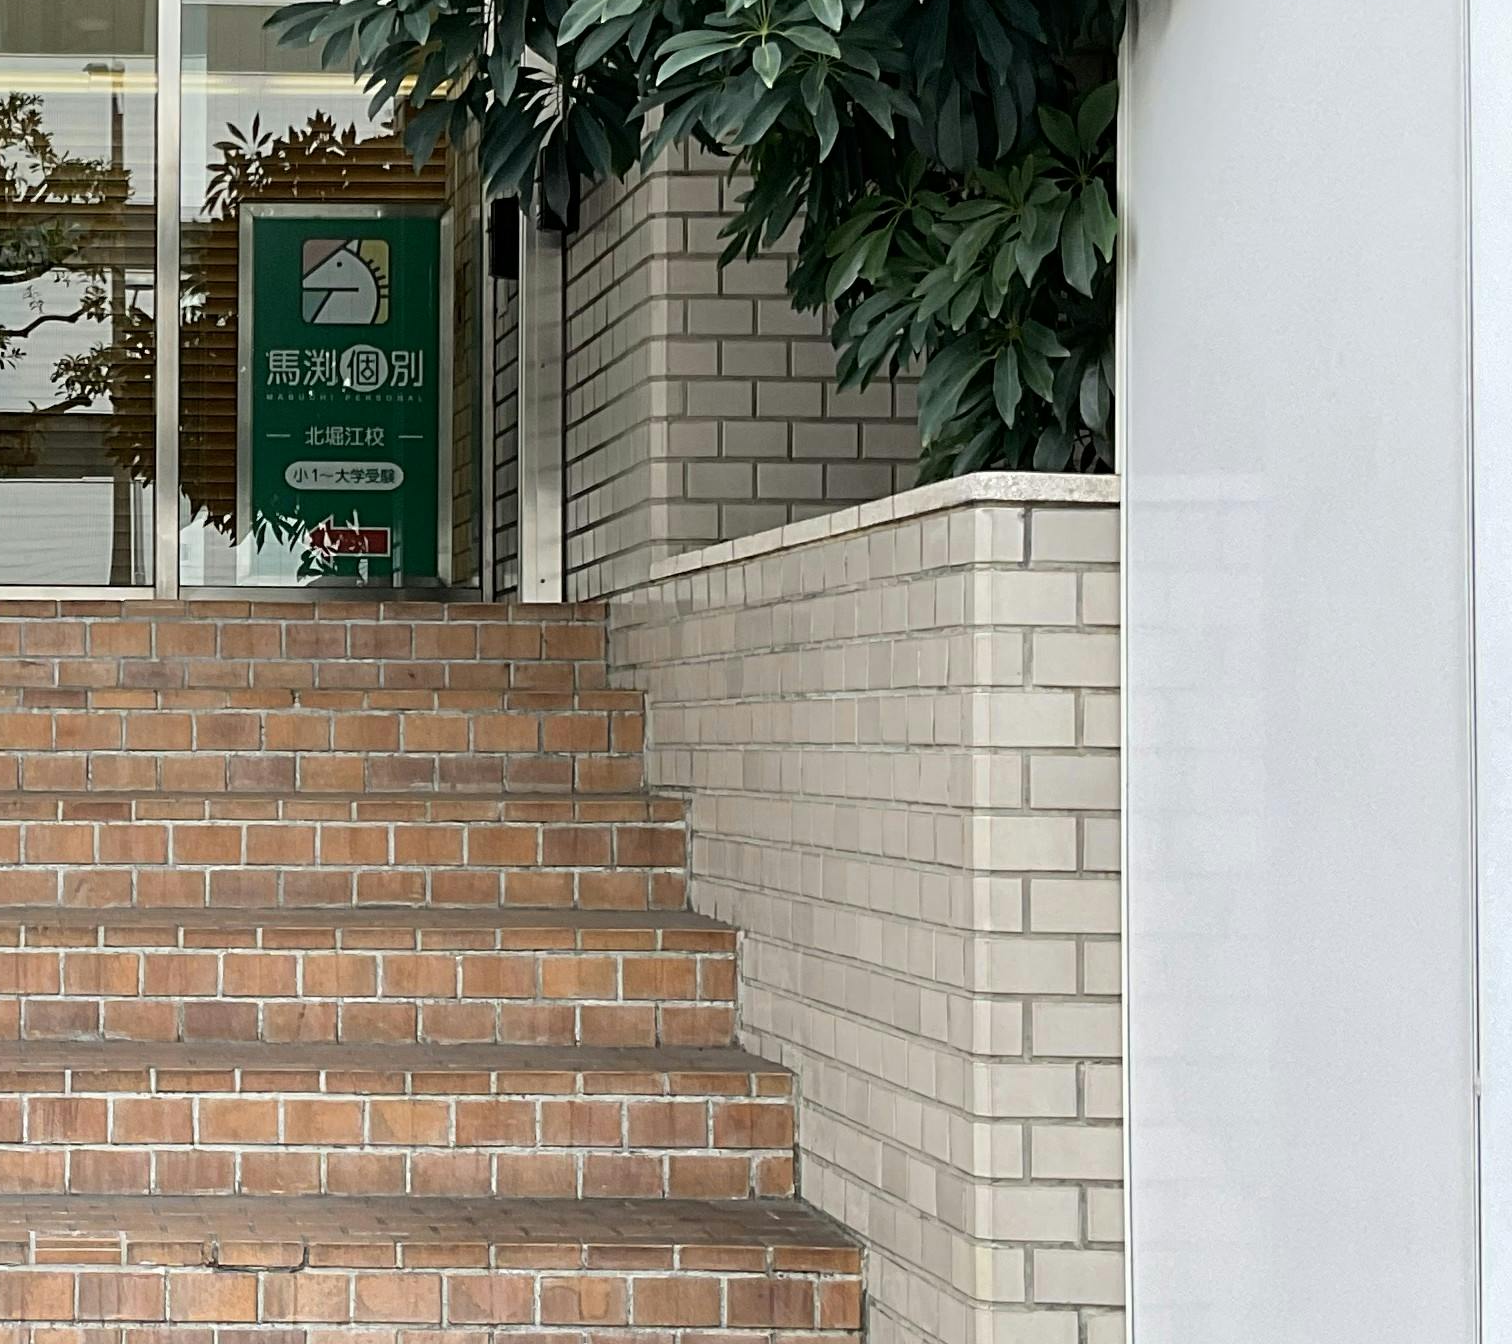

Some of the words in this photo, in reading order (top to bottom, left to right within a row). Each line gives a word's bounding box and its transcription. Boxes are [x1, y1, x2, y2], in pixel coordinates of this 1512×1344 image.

[266, 345, 424, 391] 馬渕個別
[345, 394, 423, 402] PERSONAL
[305, 426, 385, 446] 北堀江校
